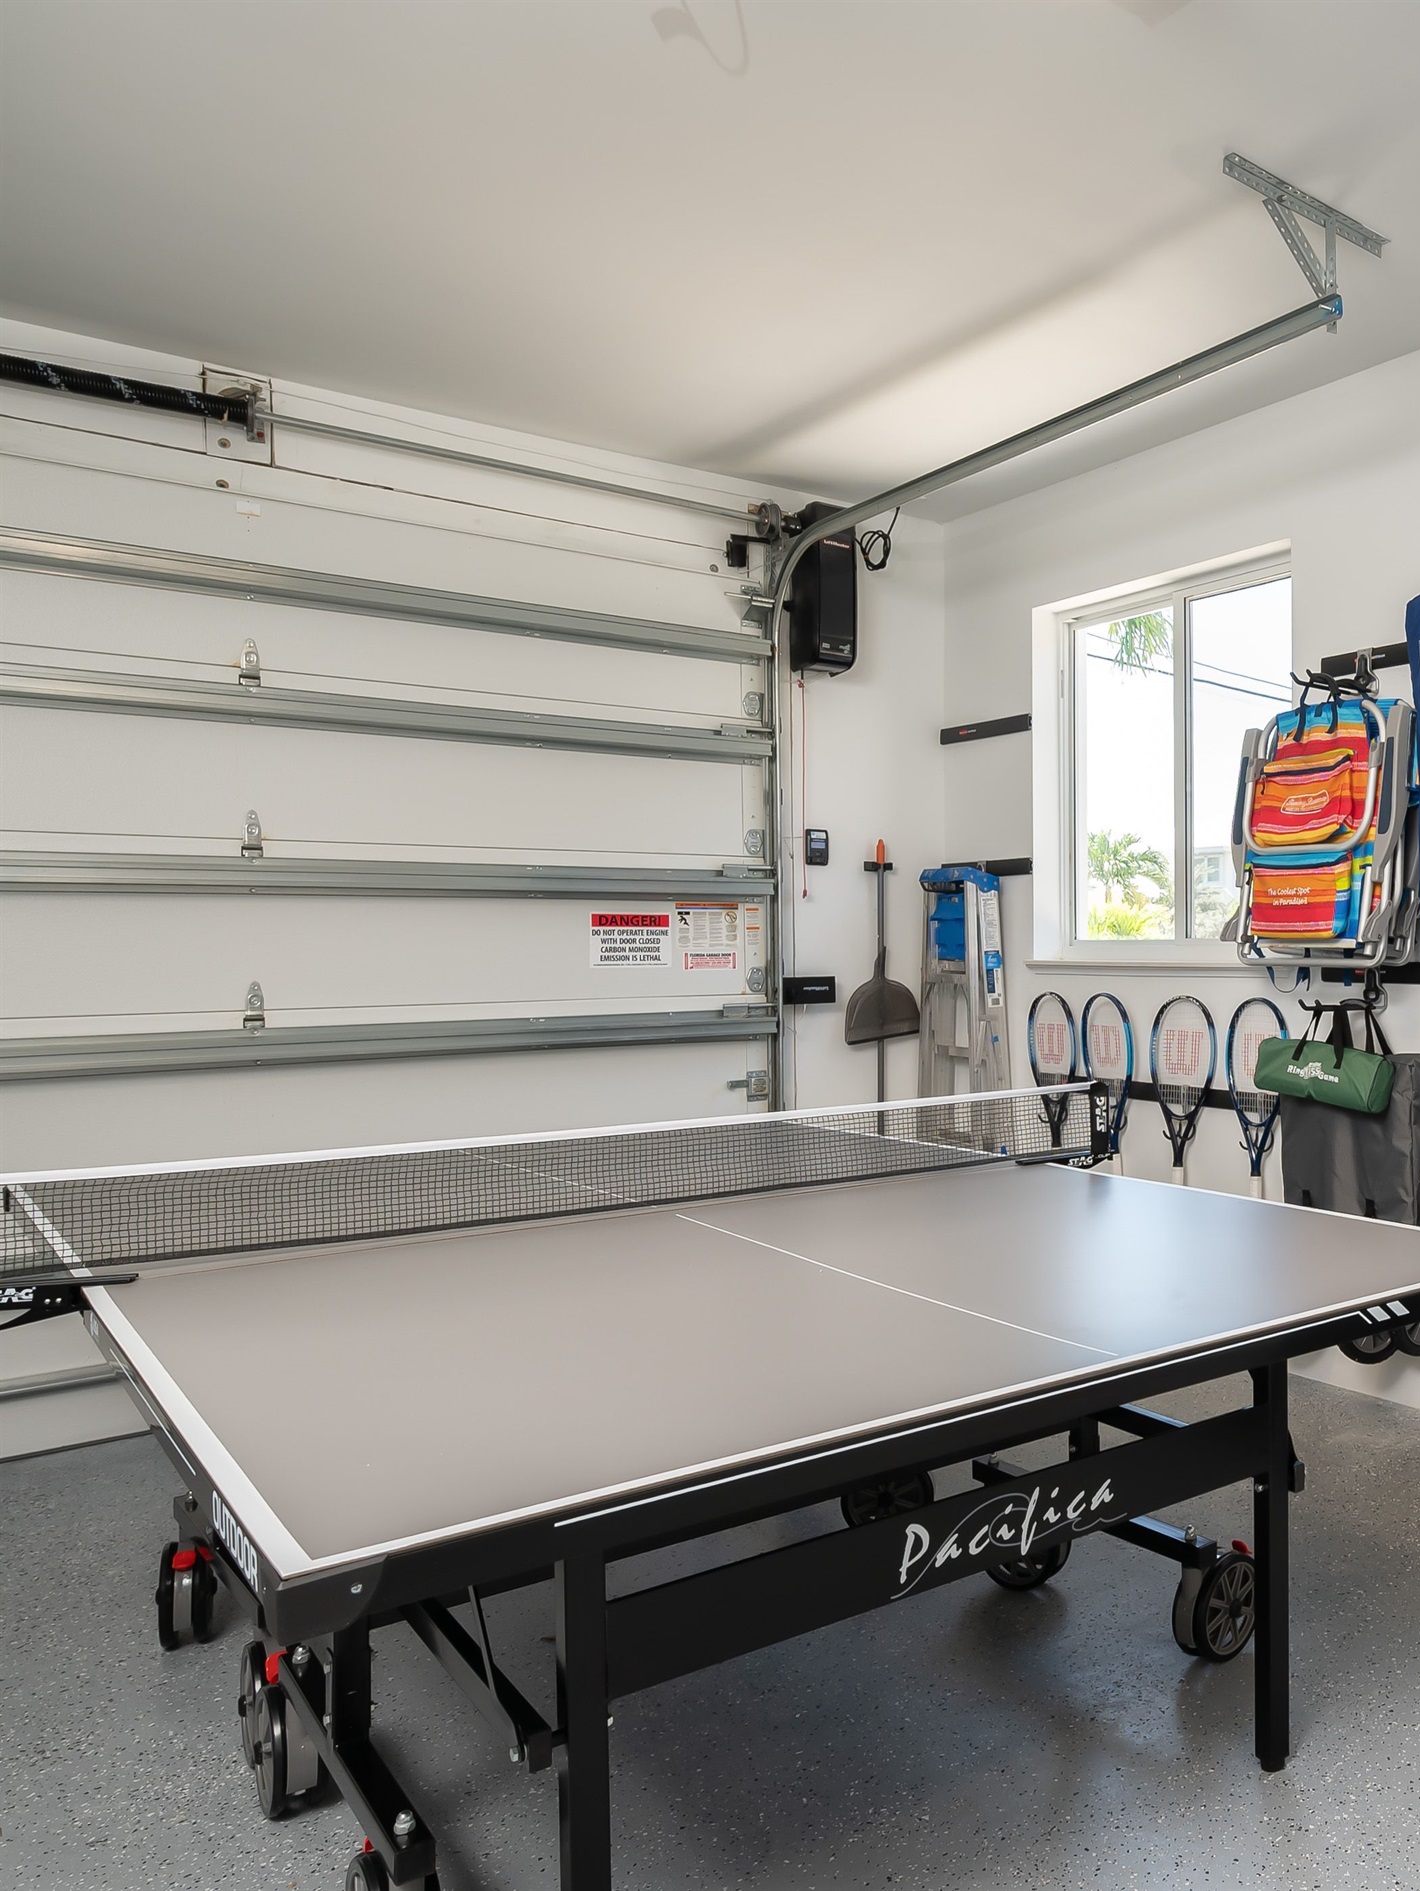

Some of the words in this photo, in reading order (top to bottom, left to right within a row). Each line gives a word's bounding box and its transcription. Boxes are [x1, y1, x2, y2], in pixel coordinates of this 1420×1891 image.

[1267, 887, 1277, 896] The
[1277, 886, 1297, 896] Coolest
[1297, 886, 1311, 896] Spot
[598, 915, 661, 926] DANGER!
[591, 929, 602, 937] DO
[602, 929, 616, 937] NOT
[617, 929, 645, 937] OPERATE
[646, 929, 669, 937] ENGINE
[1286, 1064, 1305, 1078] Ring
[1318, 1071, 1339, 1083] Game
[1095, 1096, 1107, 1133] STAG
[1067, 1156, 1094, 1167] STAG
[899, 1479, 1114, 1584] Pacifica
[212, 1490, 258, 1593] OUTDOOR
